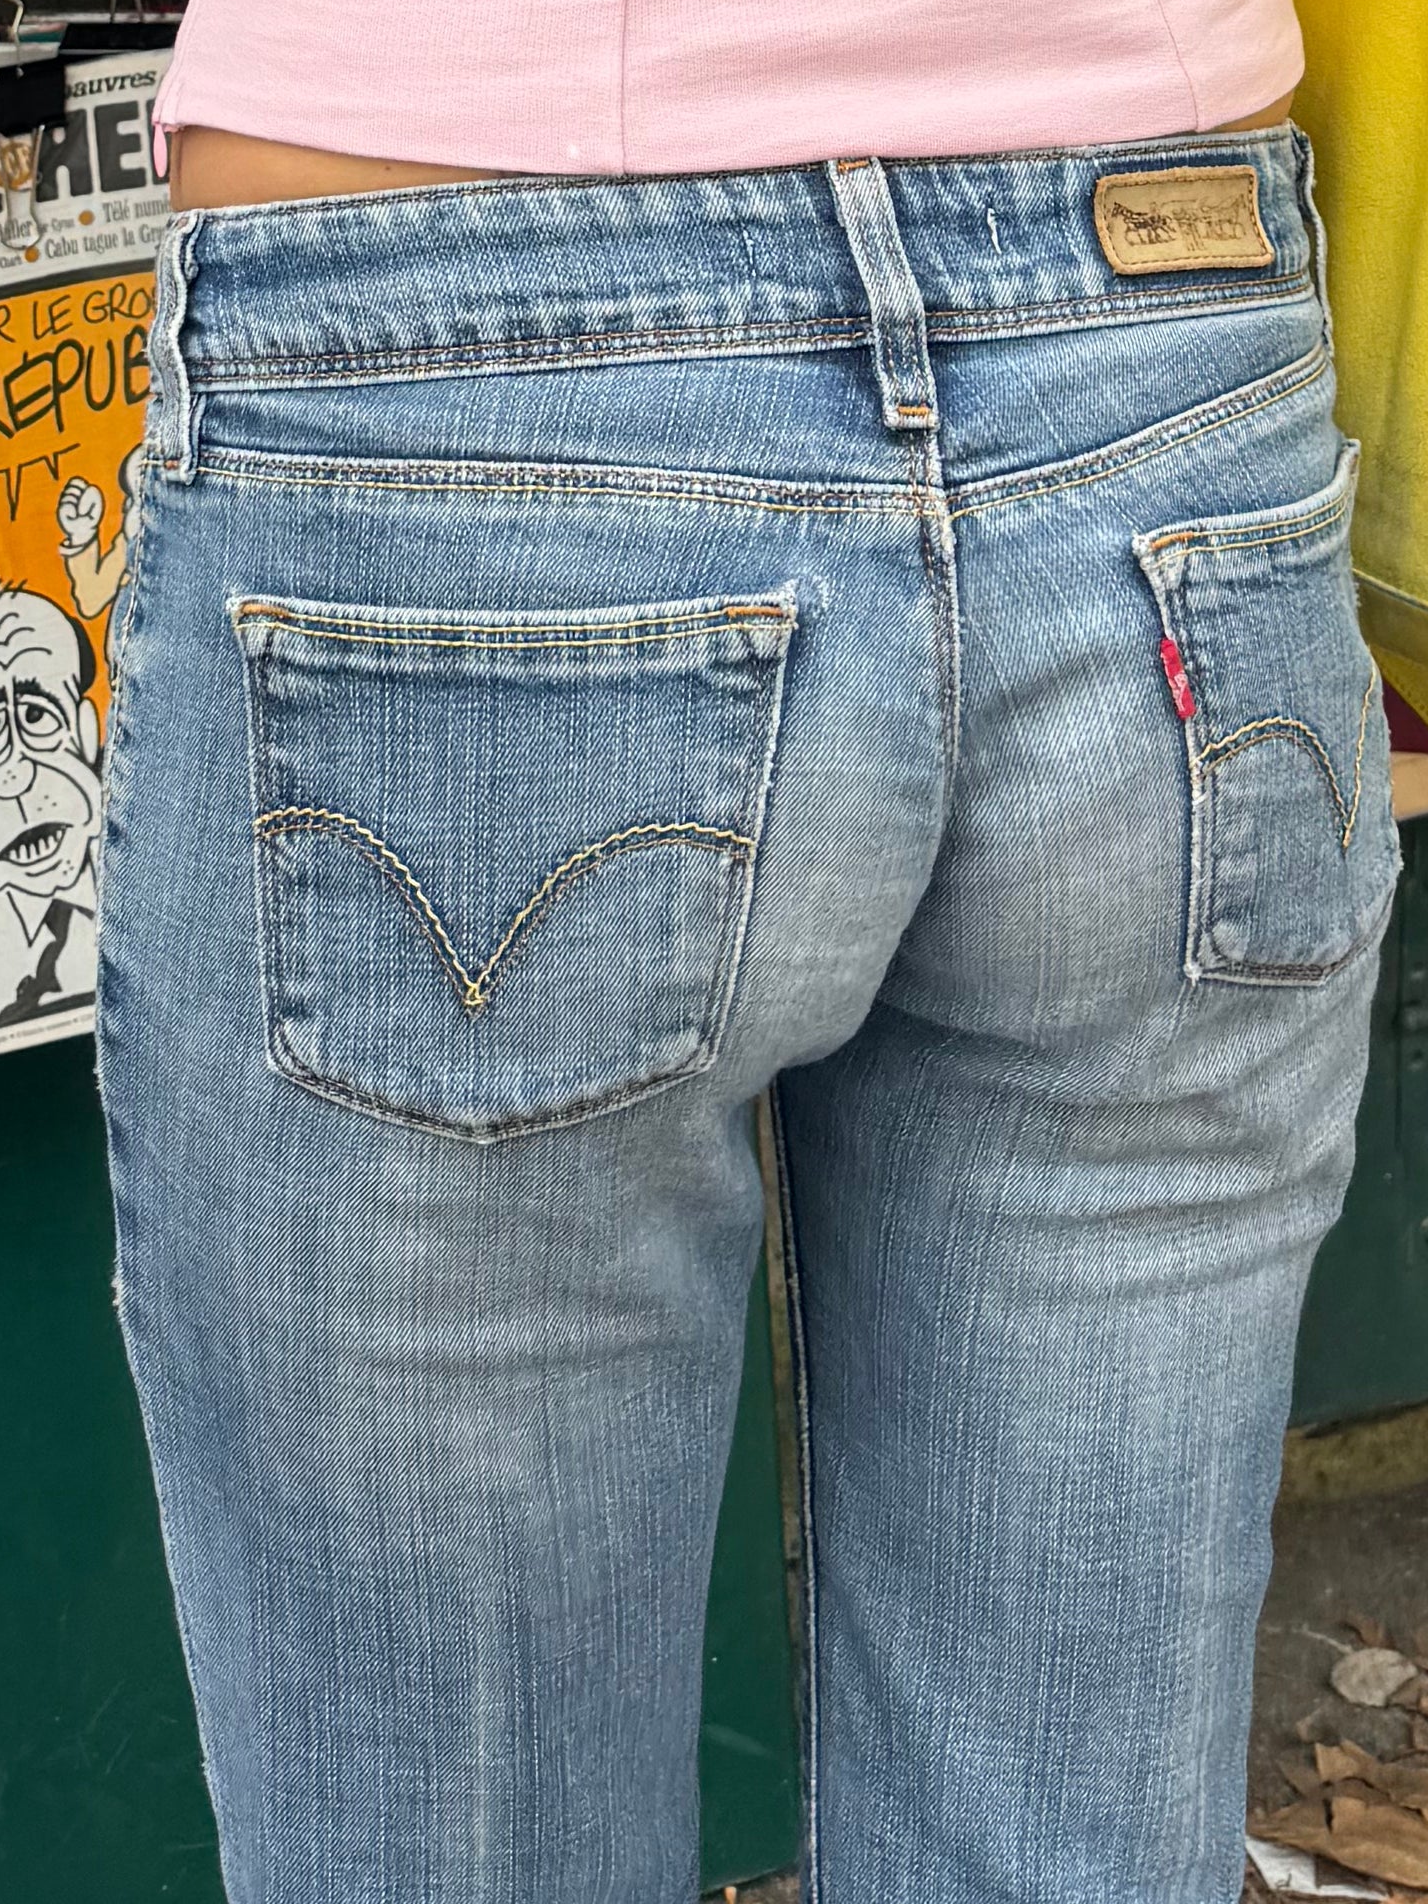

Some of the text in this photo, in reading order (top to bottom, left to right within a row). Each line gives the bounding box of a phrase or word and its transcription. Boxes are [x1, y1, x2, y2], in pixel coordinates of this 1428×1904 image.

[102, 198, 131, 223] Télé
[44, 235, 80, 260] Cabu
[82, 227, 120, 256] tague
[122, 222, 136, 242] la
[32, 293, 73, 340] LE
